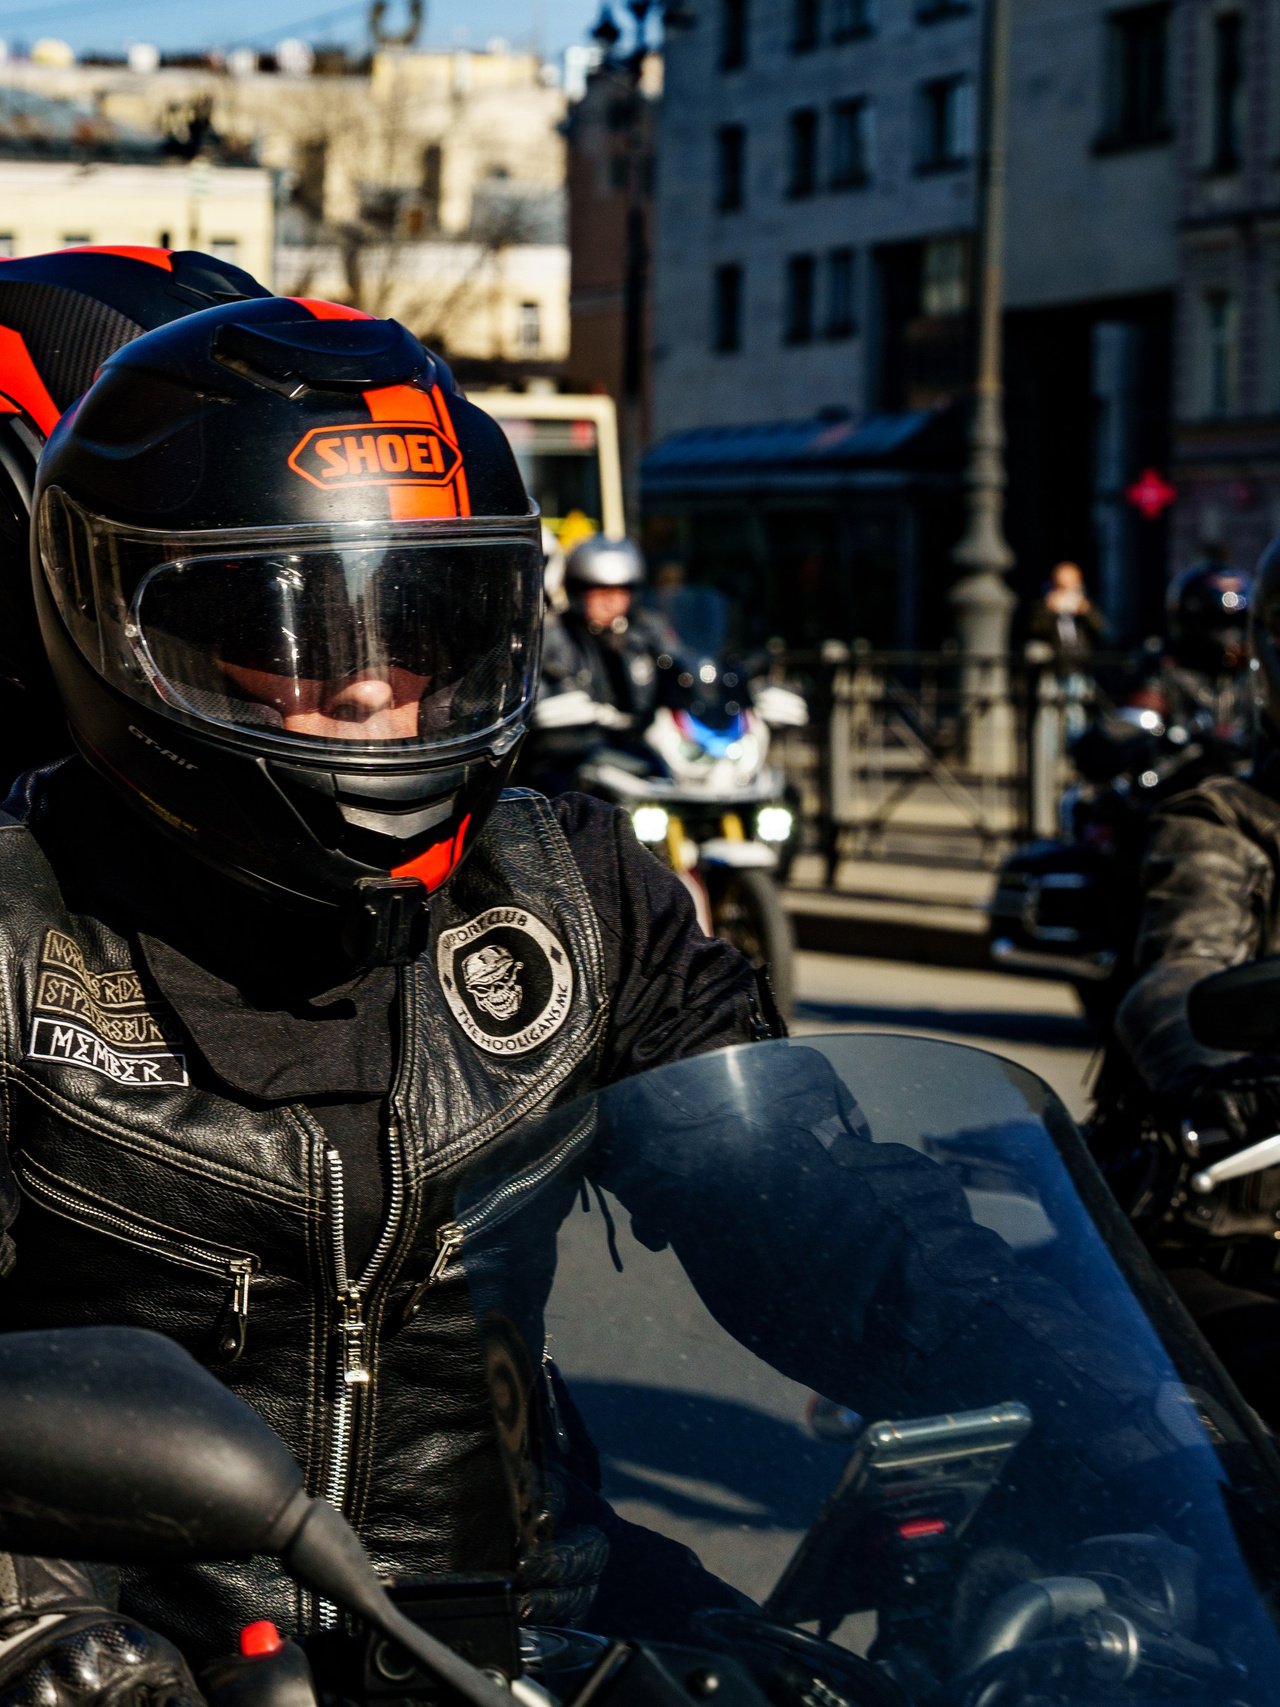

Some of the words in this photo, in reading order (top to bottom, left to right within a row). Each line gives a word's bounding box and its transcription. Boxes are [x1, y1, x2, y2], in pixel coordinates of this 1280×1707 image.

[315, 434, 445, 478] SHOEI
[488, 911, 528, 927] CLUB
[458, 1006, 479, 1038] THE
[481, 1006, 562, 1050] HOOLIGANS
[555, 983, 568, 1009] MC
[50, 1025, 163, 1082] MEMBER
